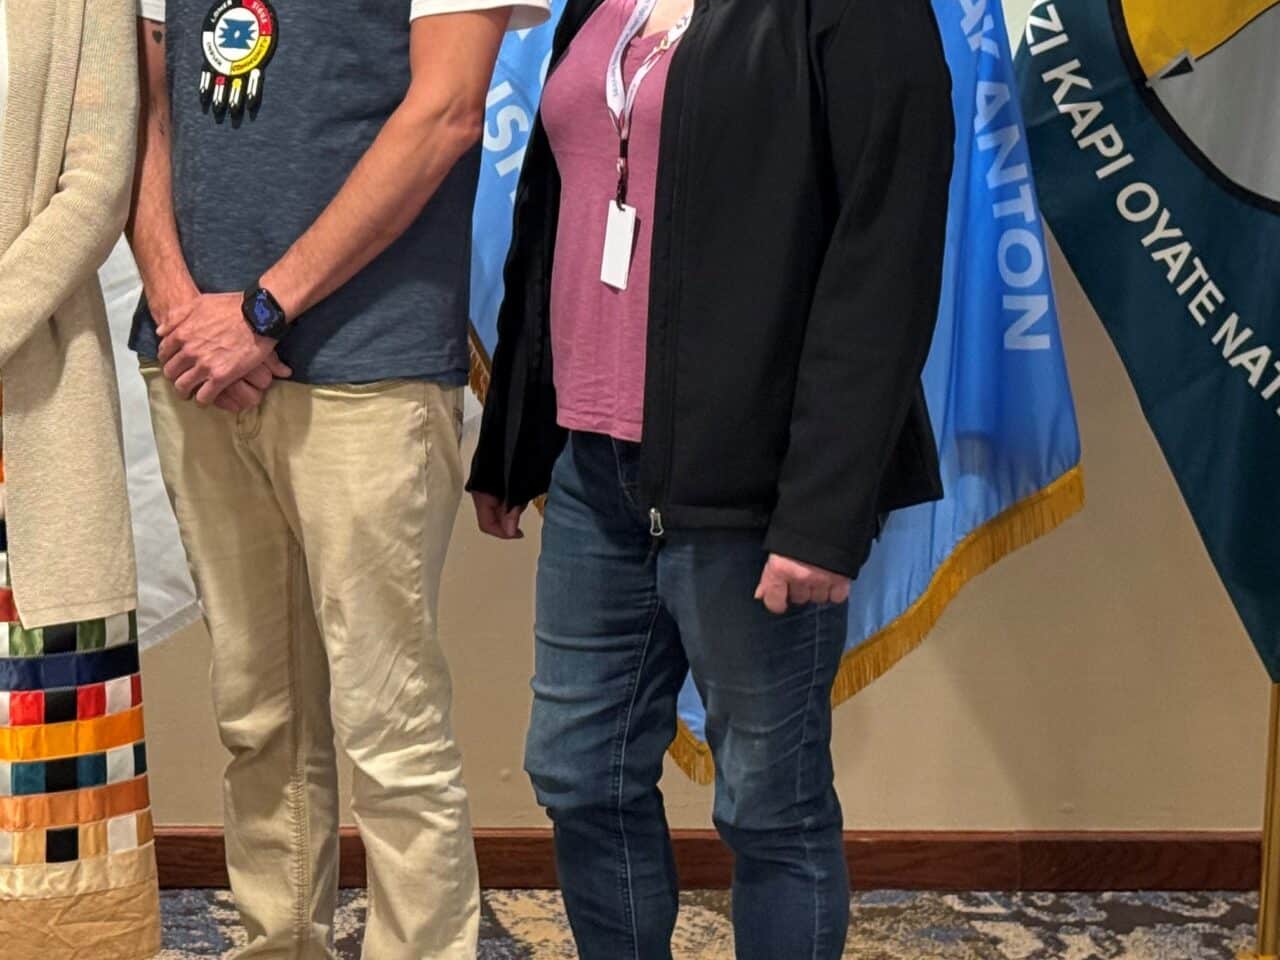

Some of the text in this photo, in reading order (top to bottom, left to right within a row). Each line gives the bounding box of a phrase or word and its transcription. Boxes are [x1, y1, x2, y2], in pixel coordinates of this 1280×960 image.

[1042, 58, 1135, 179] KAPI
[1115, 181, 1224, 327] OYATE
[1211, 311, 1280, 417] NAT
